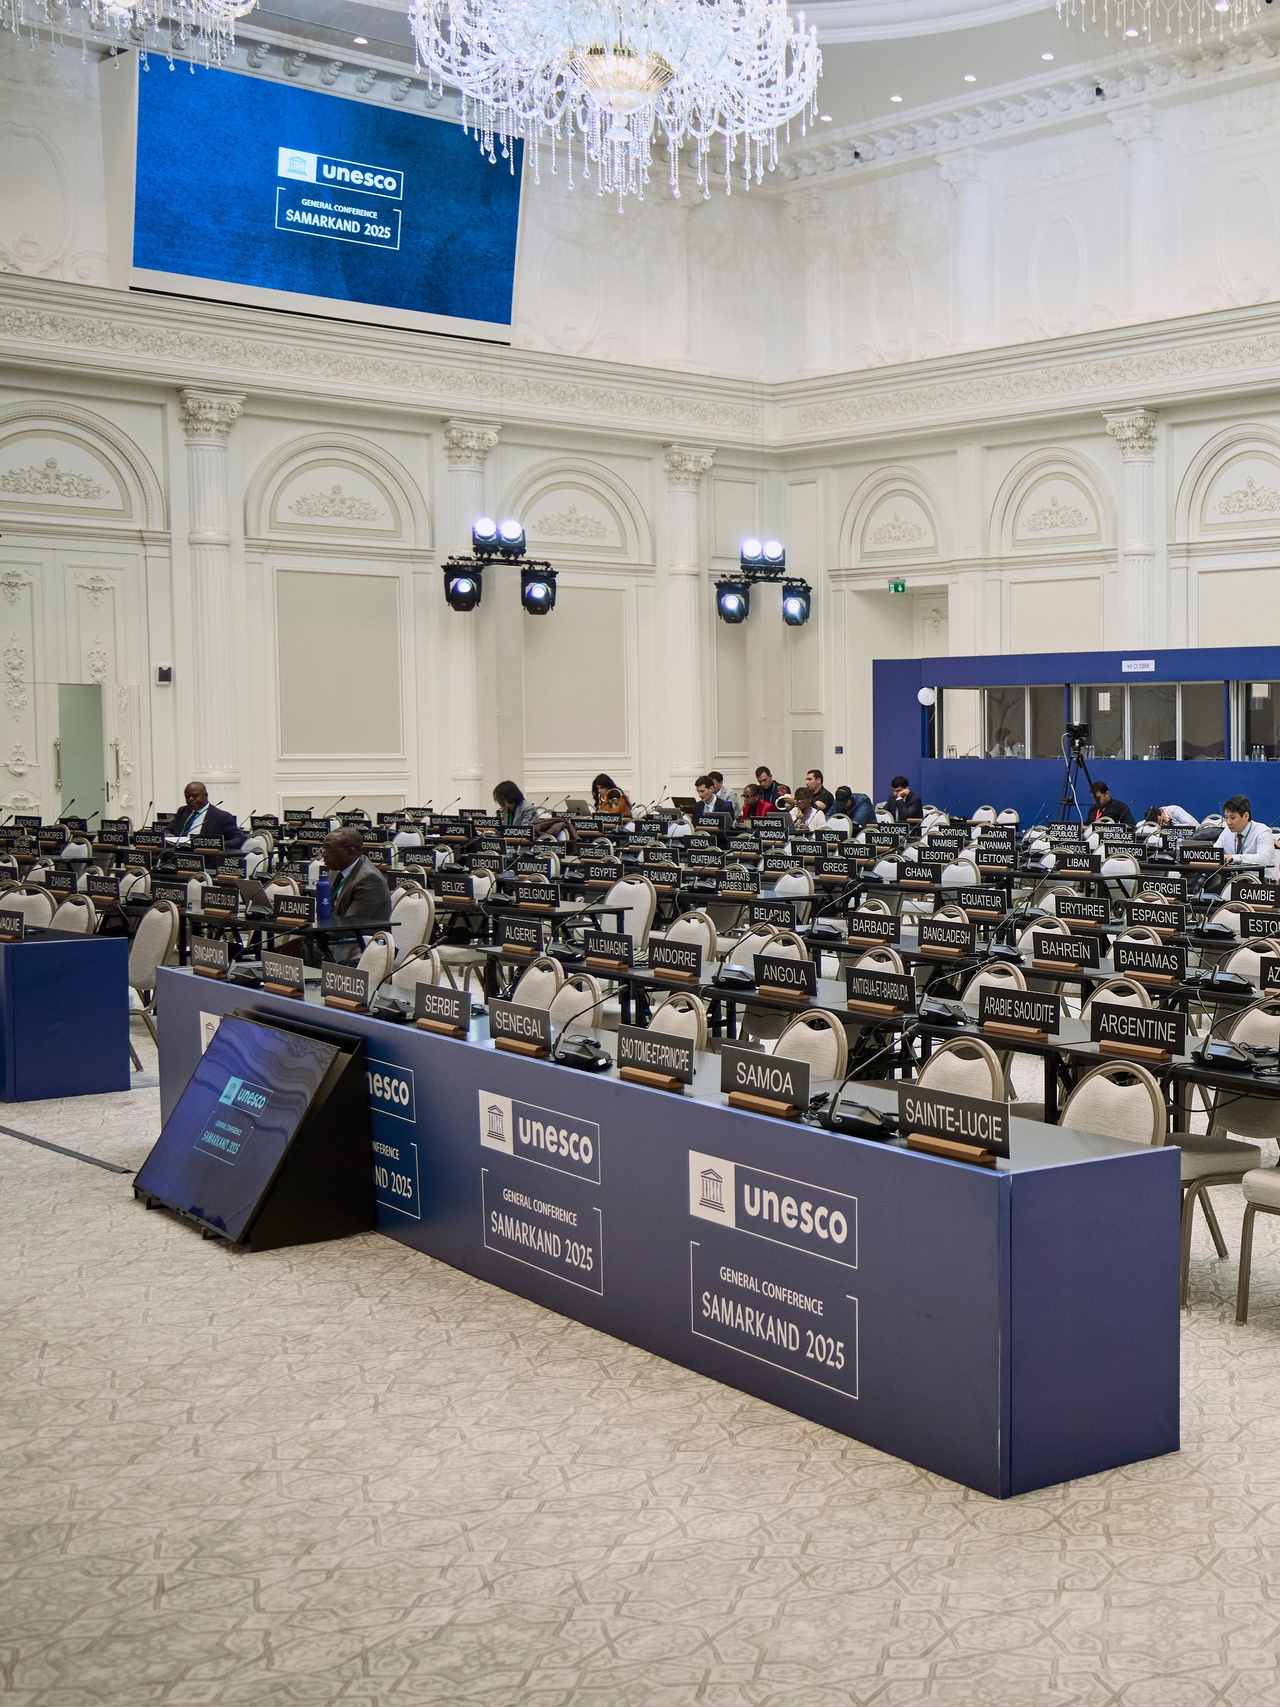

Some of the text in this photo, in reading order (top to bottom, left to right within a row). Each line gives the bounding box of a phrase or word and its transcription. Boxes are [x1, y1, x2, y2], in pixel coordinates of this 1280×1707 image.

[323, 163, 397, 192] unesco
[301, 198, 378, 219] GENERAL CONFERENCE
[286, 209, 391, 240] SAMARKAND 2025
[445, 826, 465, 834] JAPON
[474, 819, 500, 827] NORVEGE
[574, 821, 598, 829] NIGERIA
[754, 819, 781, 827] PHILIPPINES
[880, 825, 907, 833] POLOGNE
[38, 830, 64, 839] COMORES
[103, 833, 124, 842] CONGO
[822, 832, 841, 841] NEPAL
[941, 827, 968, 836] PORTUGAL
[987, 829, 1008, 838] QATAR
[481, 841, 501, 850] GUYANA
[690, 838, 709, 847] KENYA
[796, 843, 822, 853] KIRIBATI
[932, 838, 958, 847] NAMIBIE
[980, 840, 1012, 850] MYANMAR
[368, 850, 384, 860] CUBA
[405, 853, 434, 864] DANEMARK
[649, 851, 673, 861] GUINEE
[690, 853, 722, 865] GUATEMALA
[921, 850, 955, 860] LESOTHO
[978, 852, 1014, 864] LETTONIE
[1183, 849, 1220, 860] MONGOLIE
[177, 858, 201, 868] BOTSWANA
[471, 857, 500, 869] DJIBOUTI
[517, 862, 548, 873] DOMINIQUE
[766, 858, 801, 870] GRENADE
[822, 861, 849, 873] GRECE
[1066, 857, 1090, 868] LIBAN
[589, 866, 618, 879] EGYPTE
[905, 867, 933, 878] GHANA
[51, 875, 72, 888] ZAMBIE
[441, 880, 466, 894] BELIZE
[718, 879, 757, 892] ARABES UNIS
[1142, 880, 1182, 895] GEORGIE
[518, 887, 556, 901] BELGIQUE
[961, 892, 1003, 908] EQUATEUR
[1239, 888, 1276, 902] GAMBIE
[279, 900, 311, 916] ALBANIE
[753, 907, 791, 923] BELARUS
[1059, 902, 1105, 918] ERYTHREE
[1131, 907, 1179, 925] ESPAGNE
[505, 924, 538, 943] ALGERIE
[852, 917, 896, 937] BARBADE
[922, 925, 971, 945] BANGLADESH
[587, 937, 629, 957] ALLEMAGNE
[1041, 939, 1092, 960] BAHREÏN
[193, 944, 225, 966] SINGAPOUR
[652, 946, 697, 968] ANDORRE
[1119, 948, 1179, 971] BAHAMAS
[762, 963, 808, 986] ANGOLA
[325, 971, 366, 997] SEYCHELLES
[424, 993, 461, 1019] SERBIE
[983, 995, 1055, 1024] ARABIE SAOUDITE
[494, 1009, 546, 1040] SENEGAL
[1098, 1012, 1177, 1043] ARGENTINE
[620, 1036, 690, 1072] SAO TOME-ET-PRINCIPE
[735, 1060, 795, 1096] SAMOA
[237, 1089, 266, 1109] unesco
[904, 1096, 1004, 1143] SAINTE-LUCIE
[518, 1115, 594, 1165] unesco
[391, 1171, 413, 1199] 2025
[502, 1187, 578, 1227] GENERAL CONFERENCE
[744, 1183, 848, 1245] unesco
[490, 1210, 594, 1272] SAMARKAND 2025
[719, 1265, 825, 1317] GENERAL CONFERENCE
[701, 1290, 846, 1371] SAMARKAND 2025
